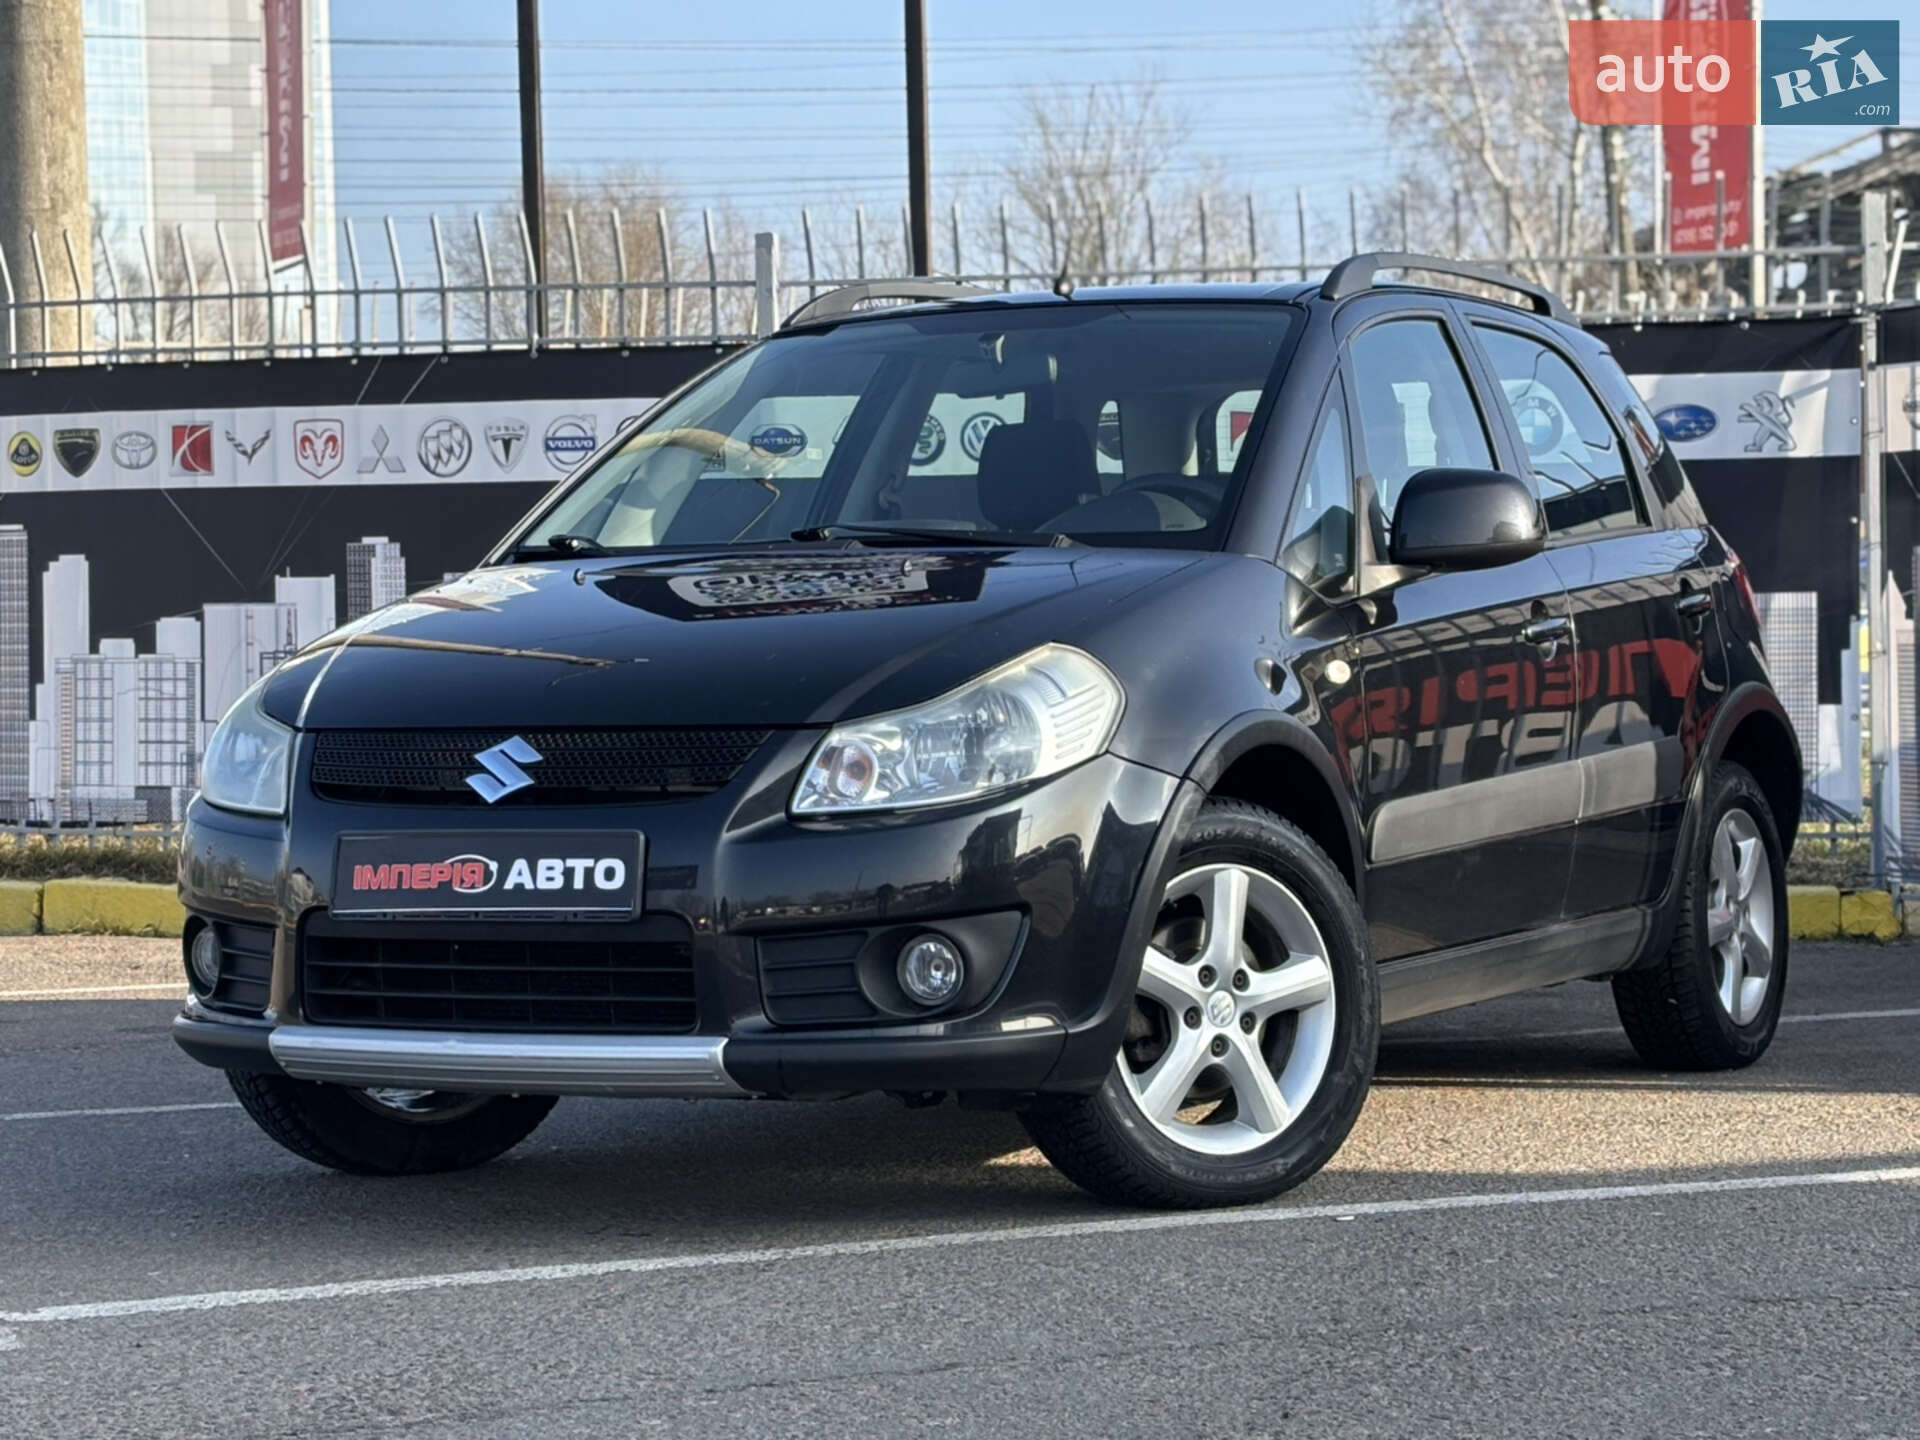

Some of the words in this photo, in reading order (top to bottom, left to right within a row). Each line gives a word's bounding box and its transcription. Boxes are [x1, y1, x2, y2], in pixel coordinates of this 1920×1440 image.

[547, 439, 594, 449] VOLVO
[753, 436, 802, 446] DATSUN
[352, 863, 485, 891] ІМПЕРІЯ
[503, 857, 626, 891] АВТО
